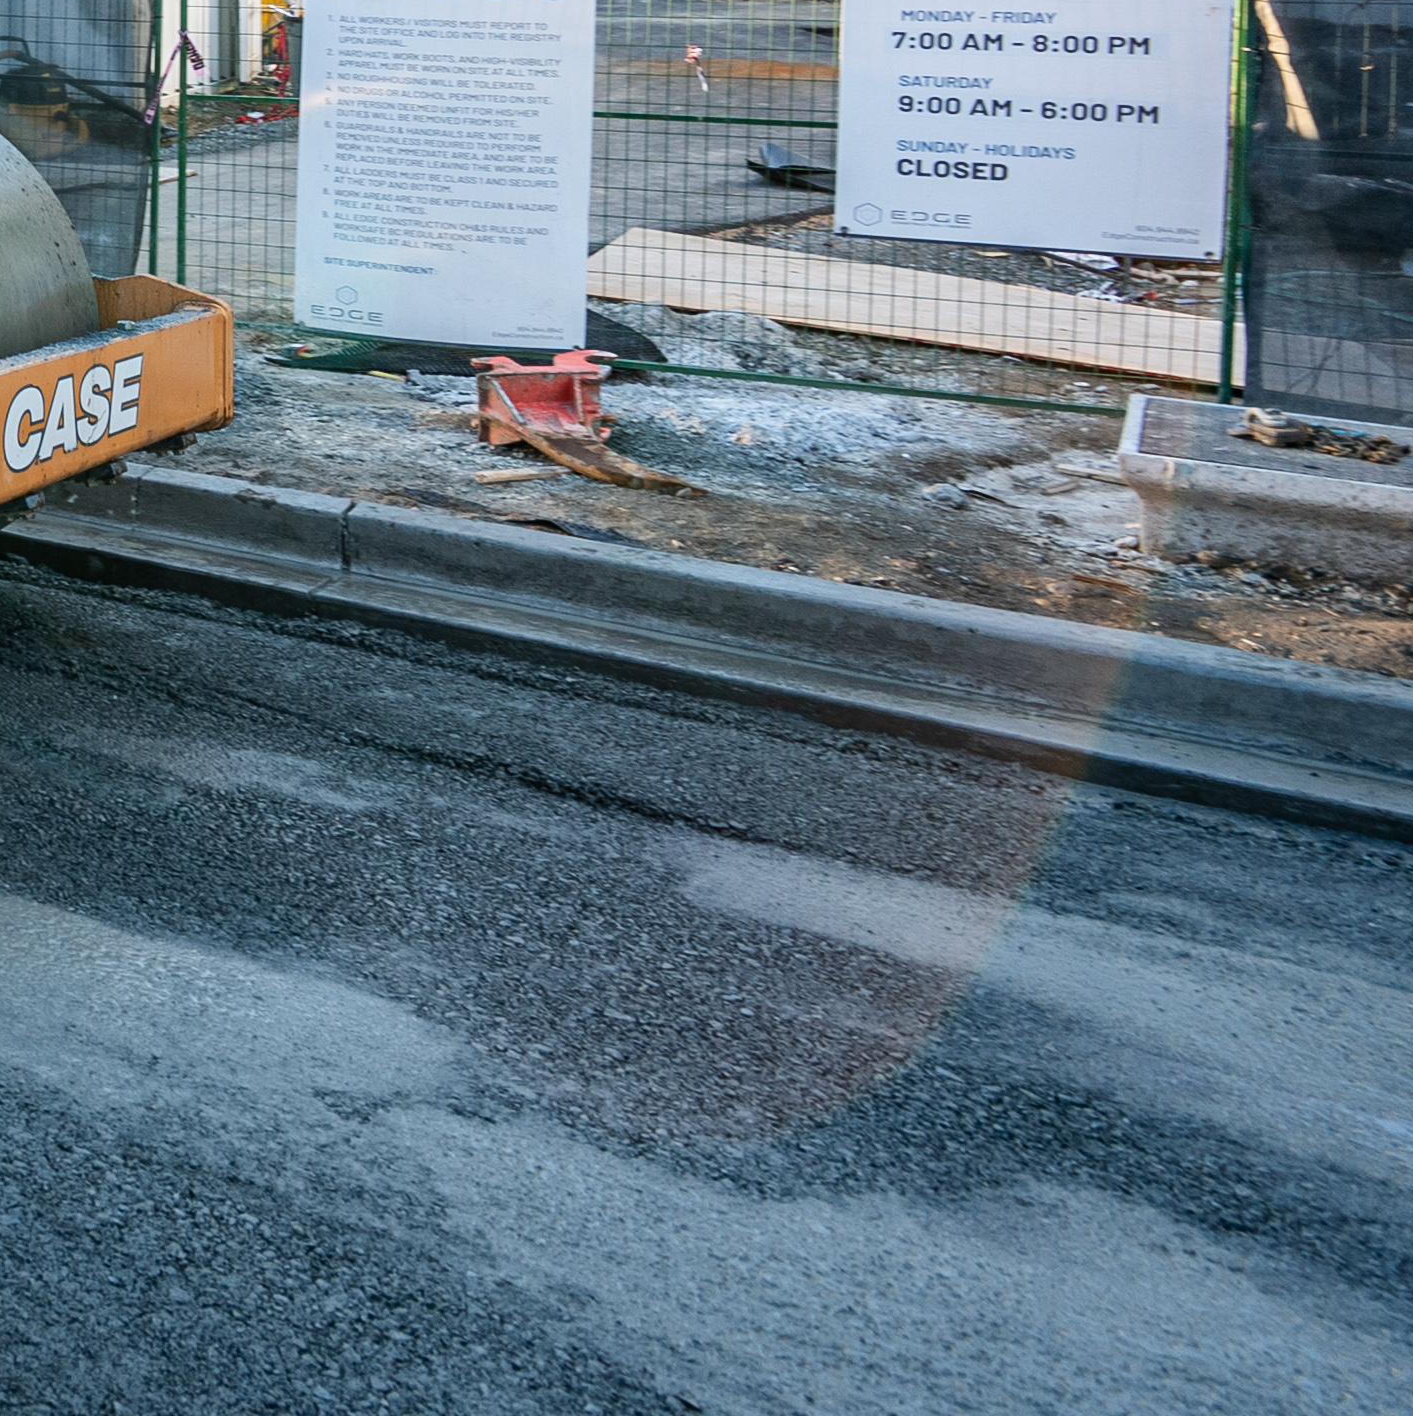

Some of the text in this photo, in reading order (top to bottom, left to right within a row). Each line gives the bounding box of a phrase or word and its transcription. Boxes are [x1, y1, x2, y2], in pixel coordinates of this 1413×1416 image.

[901, 10, 975, 22] MONDAY
[991, 11, 1057, 24] FRIDAY
[891, 32, 953, 50] 7:00
[961, 33, 1004, 51] AM
[1033, 34, 1098, 53] 8:00
[1107, 36, 1150, 55] PM
[898, 75, 993, 88] SATURDAY
[898, 95, 961, 115] 9:00
[969, 99, 1012, 117] AM
[1041, 101, 1107, 121] 6:00
[1117, 104, 1159, 124] PM
[896, 140, 968, 154] SUNDAY
[985, 144, 1076, 159] HOLIDAYS
[897, 158, 1008, 181] CLOSED
[891, 210, 972, 224] EDGE
[324, 257, 344, 265] SITE
[311, 305, 384, 322] EDGE
[3, 352, 144, 473] CASE
